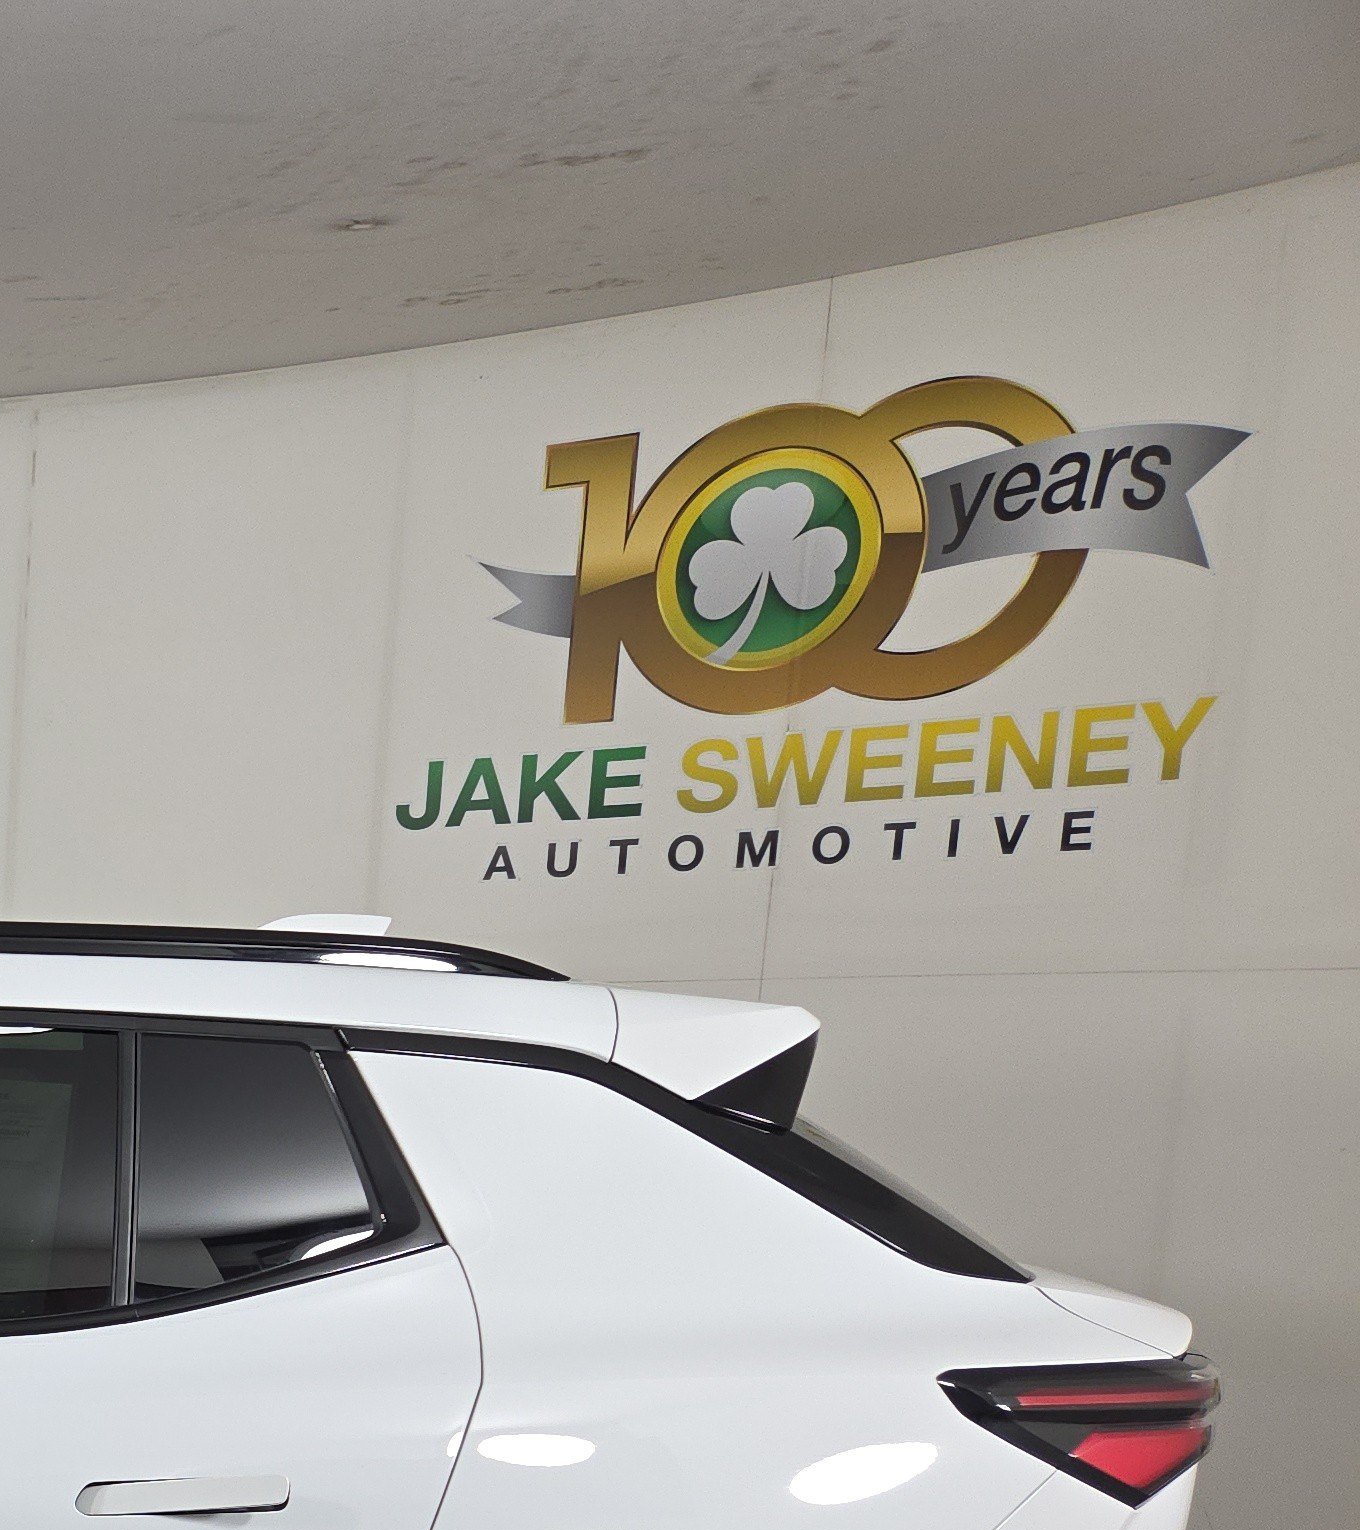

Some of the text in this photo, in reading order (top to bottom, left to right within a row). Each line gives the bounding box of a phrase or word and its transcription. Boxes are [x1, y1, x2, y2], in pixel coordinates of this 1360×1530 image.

[543, 376, 1090, 725] 100
[940, 442, 1173, 556] years
[394, 694, 1219, 831] JAKE SWEENEY
[482, 809, 1098, 882] AUTOMOTIVE
